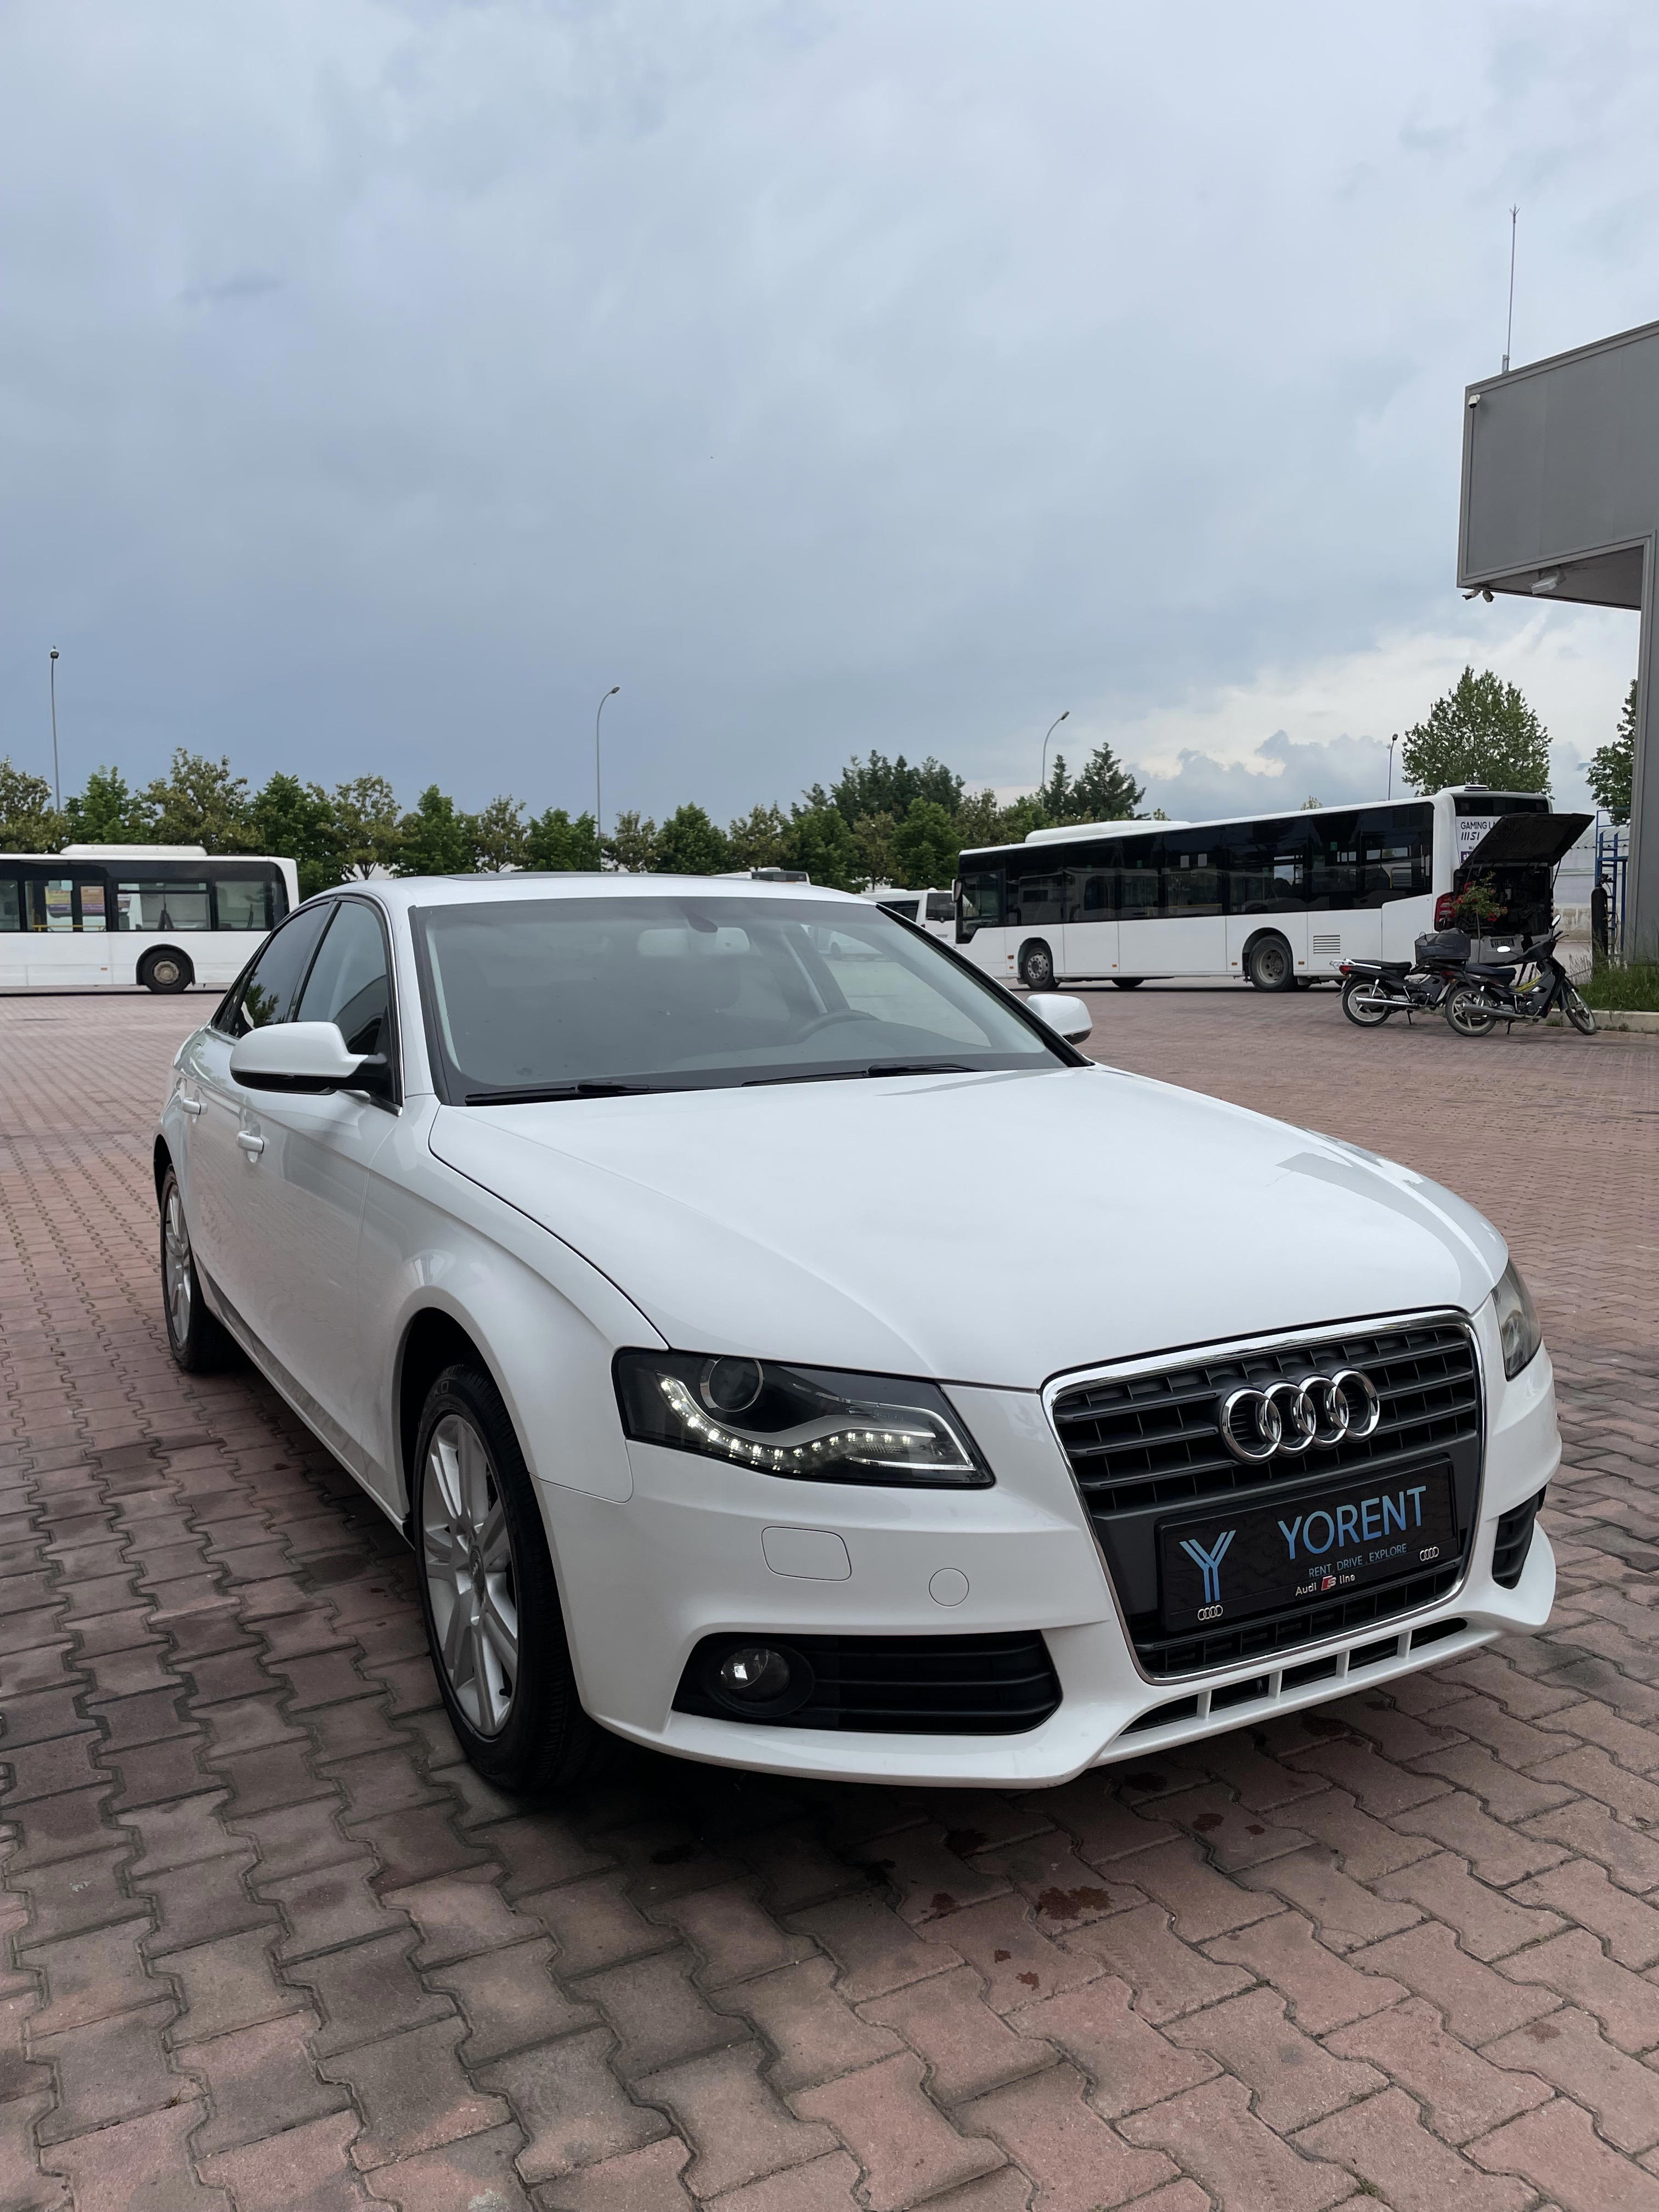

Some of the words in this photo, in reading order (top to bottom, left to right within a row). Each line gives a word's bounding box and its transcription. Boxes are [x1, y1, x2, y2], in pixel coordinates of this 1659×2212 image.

[1460, 821, 1487, 830] GAMING
[1277, 1485, 1426, 1560] YORENT
[1369, 1543, 1407, 1562] EXPLORE
[1295, 1582, 1317, 1596] Audi
[1339, 1574, 1356, 1584] line
